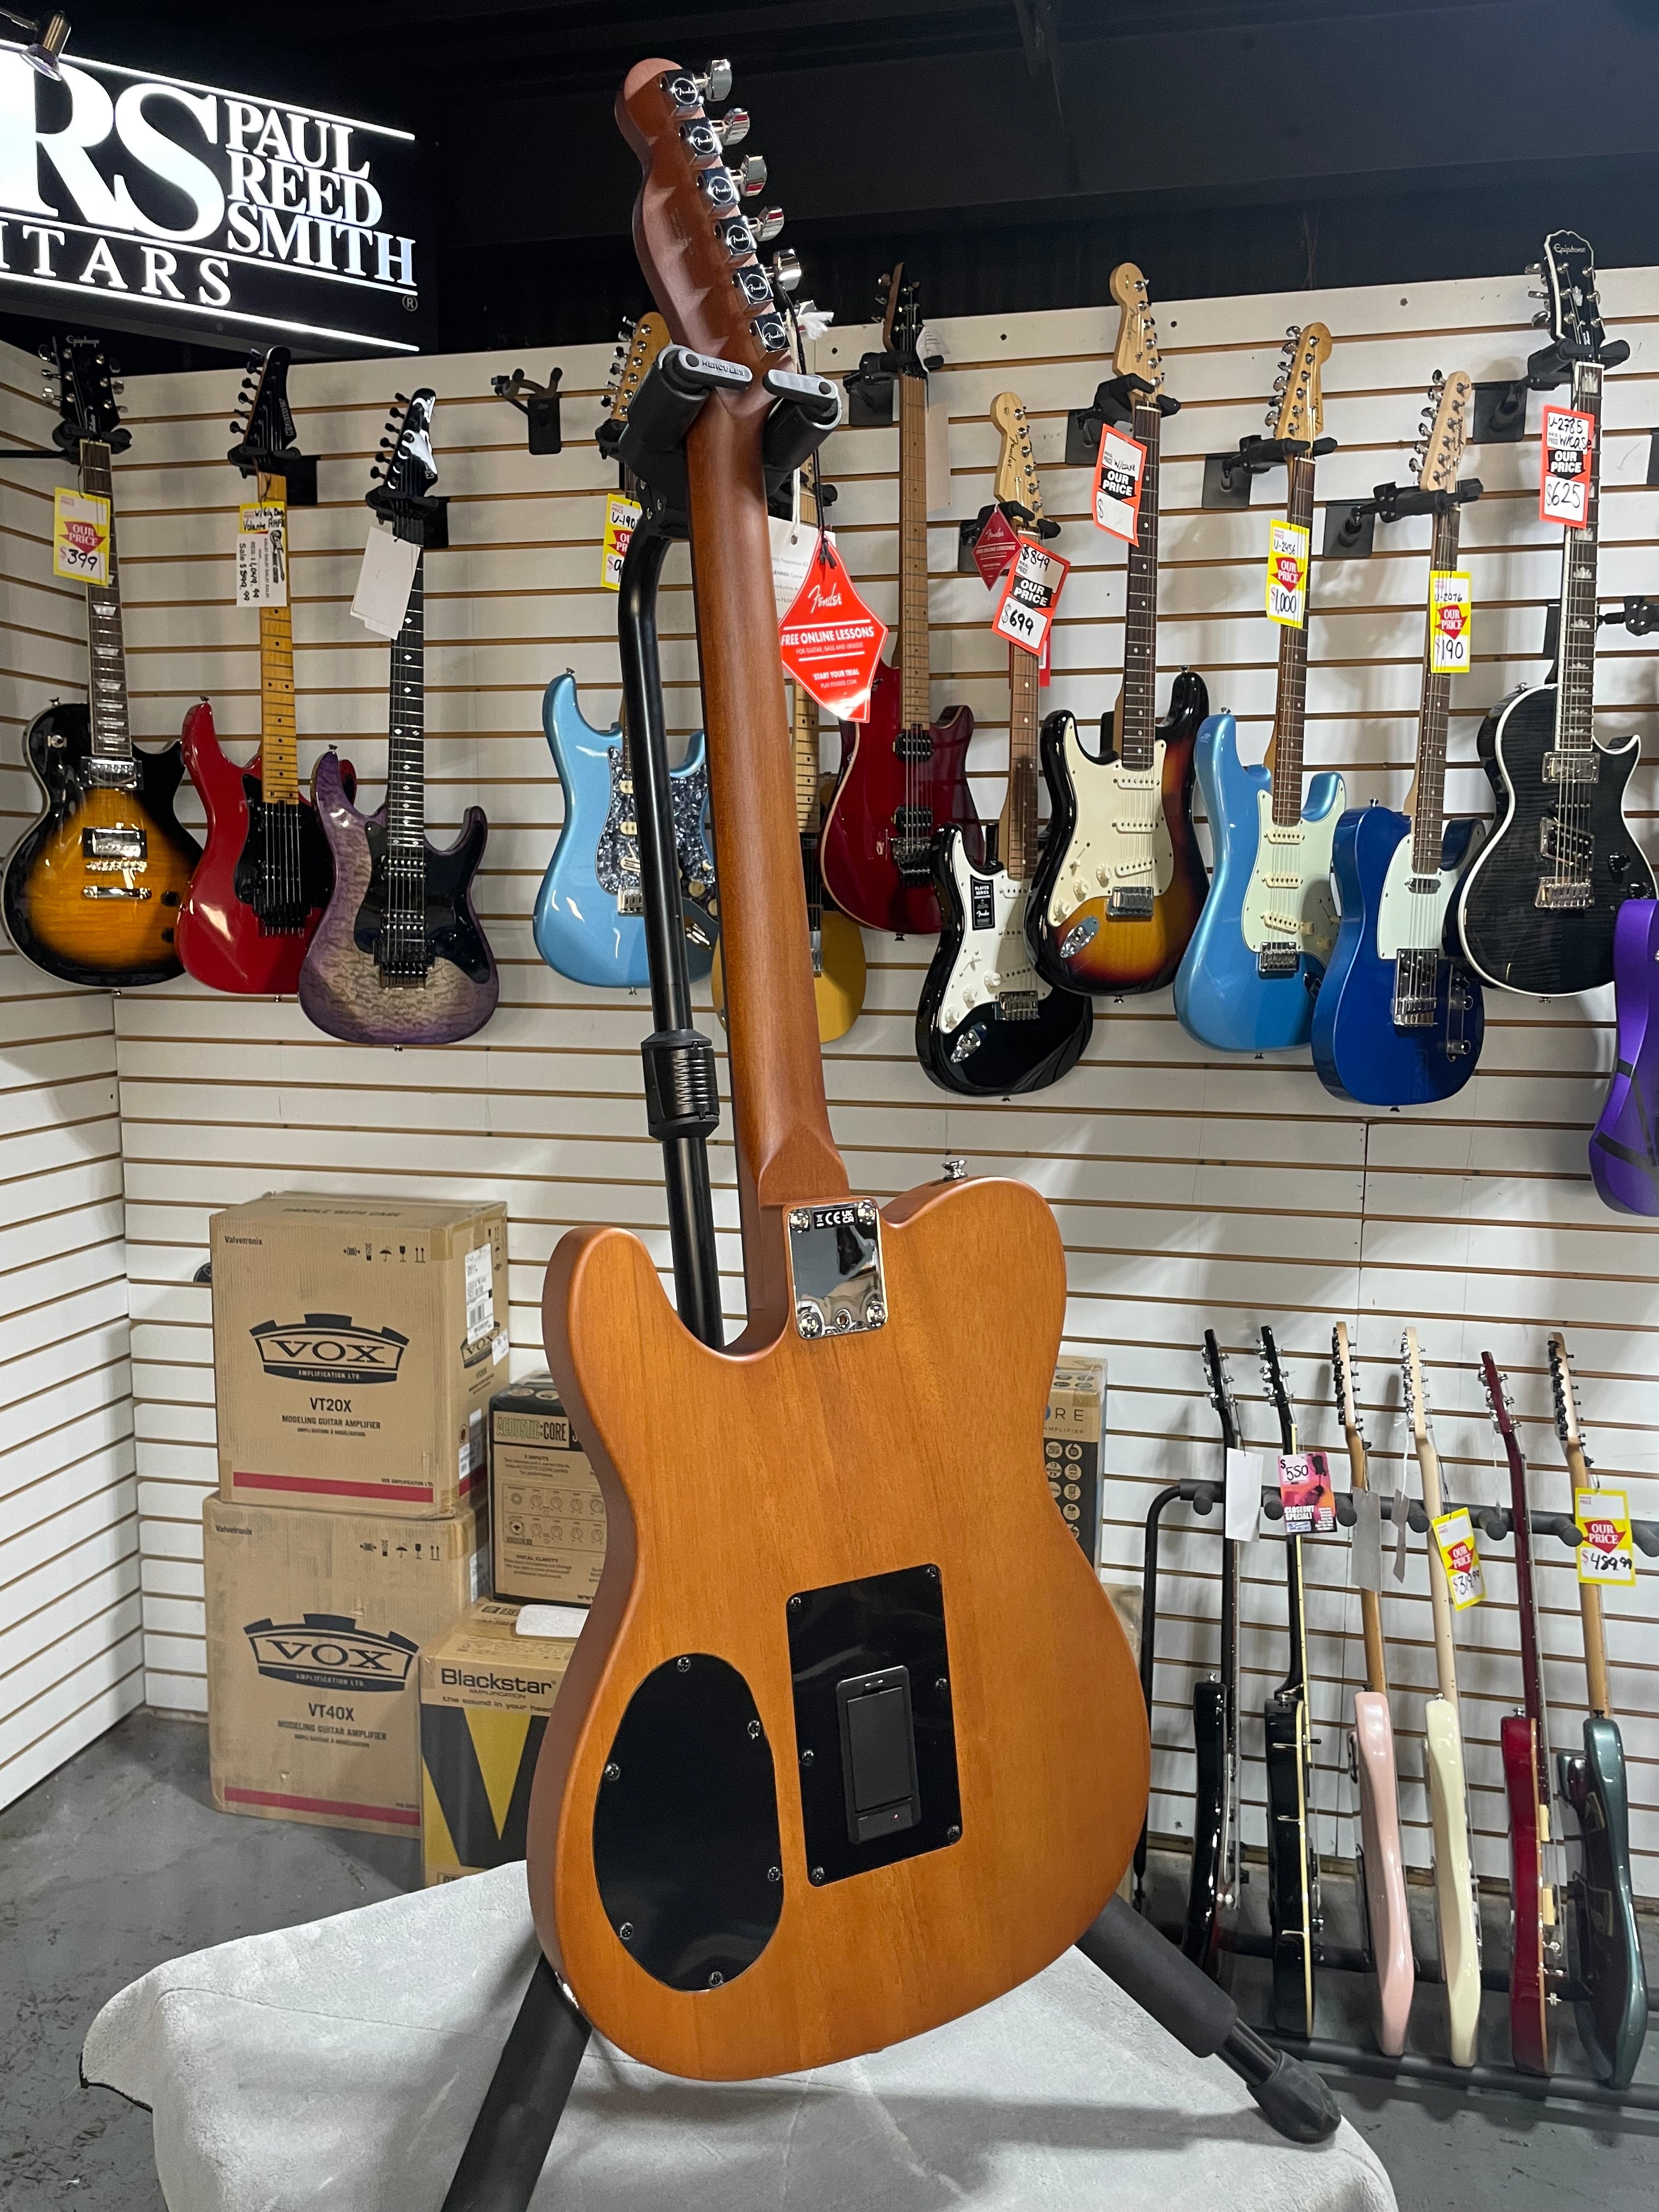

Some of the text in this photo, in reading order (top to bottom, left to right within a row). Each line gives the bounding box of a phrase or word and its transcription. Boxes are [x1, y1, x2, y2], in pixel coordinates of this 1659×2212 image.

[224, 99, 370, 180] PAUL
[227, 150, 383, 227] REED
[227, 204, 417, 286] SMITH
[702, 360, 744, 376] HERCULES
[1554, 450, 1577, 462] OUR
[1550, 461, 1582, 473] PRICE
[1107, 471, 1129, 485] OUR
[1103, 479, 1133, 496] PRICE
[1546, 482, 1581, 509] $625
[612, 512, 638, 529] U-190
[72, 523, 94, 537] OUR
[69, 532, 98, 546] PRICE
[60, 546, 98, 571] $399
[1280, 560, 1297, 573] OUR
[1278, 570, 1299, 584] PRICE
[1020, 579, 1045, 595] OUR
[808, 582, 842, 614] Fender
[1014, 586, 1048, 607] PRICE
[1271, 586, 1297, 614] $1,000
[1002, 603, 1034, 637] $699
[1443, 609, 1460, 620] OUR
[1441, 620, 1463, 630] PRICE
[781, 626, 874, 646] FREE ONLINE LESSONS
[1435, 637, 1464, 661] $190
[813, 668, 860, 680] START YOUR TRIAL
[825, 1210, 840, 1225] CE
[224, 1235, 263, 1245] Valvetronix
[270, 1339, 385, 1364] VOX
[298, 1369, 346, 1379] AMPLIFICATION
[309, 1397, 352, 1413] VT20X
[281, 1415, 381, 1430] MODELING GUITAR AMPLIFIER
[1591, 1523, 1614, 1534] OUR
[1589, 1533, 1619, 1545] PRICE
[1452, 1545, 1468, 1559] OUR
[1453, 1553, 1472, 1569] PRICE
[266, 1639, 392, 1671] VOX
[296, 1673, 348, 1685] AMPLIFICATION
[441, 1668, 552, 1694] Blackstar
[469, 1689, 526, 1699] AMPLIFICATION
[308, 1702, 355, 1722] VT40X
